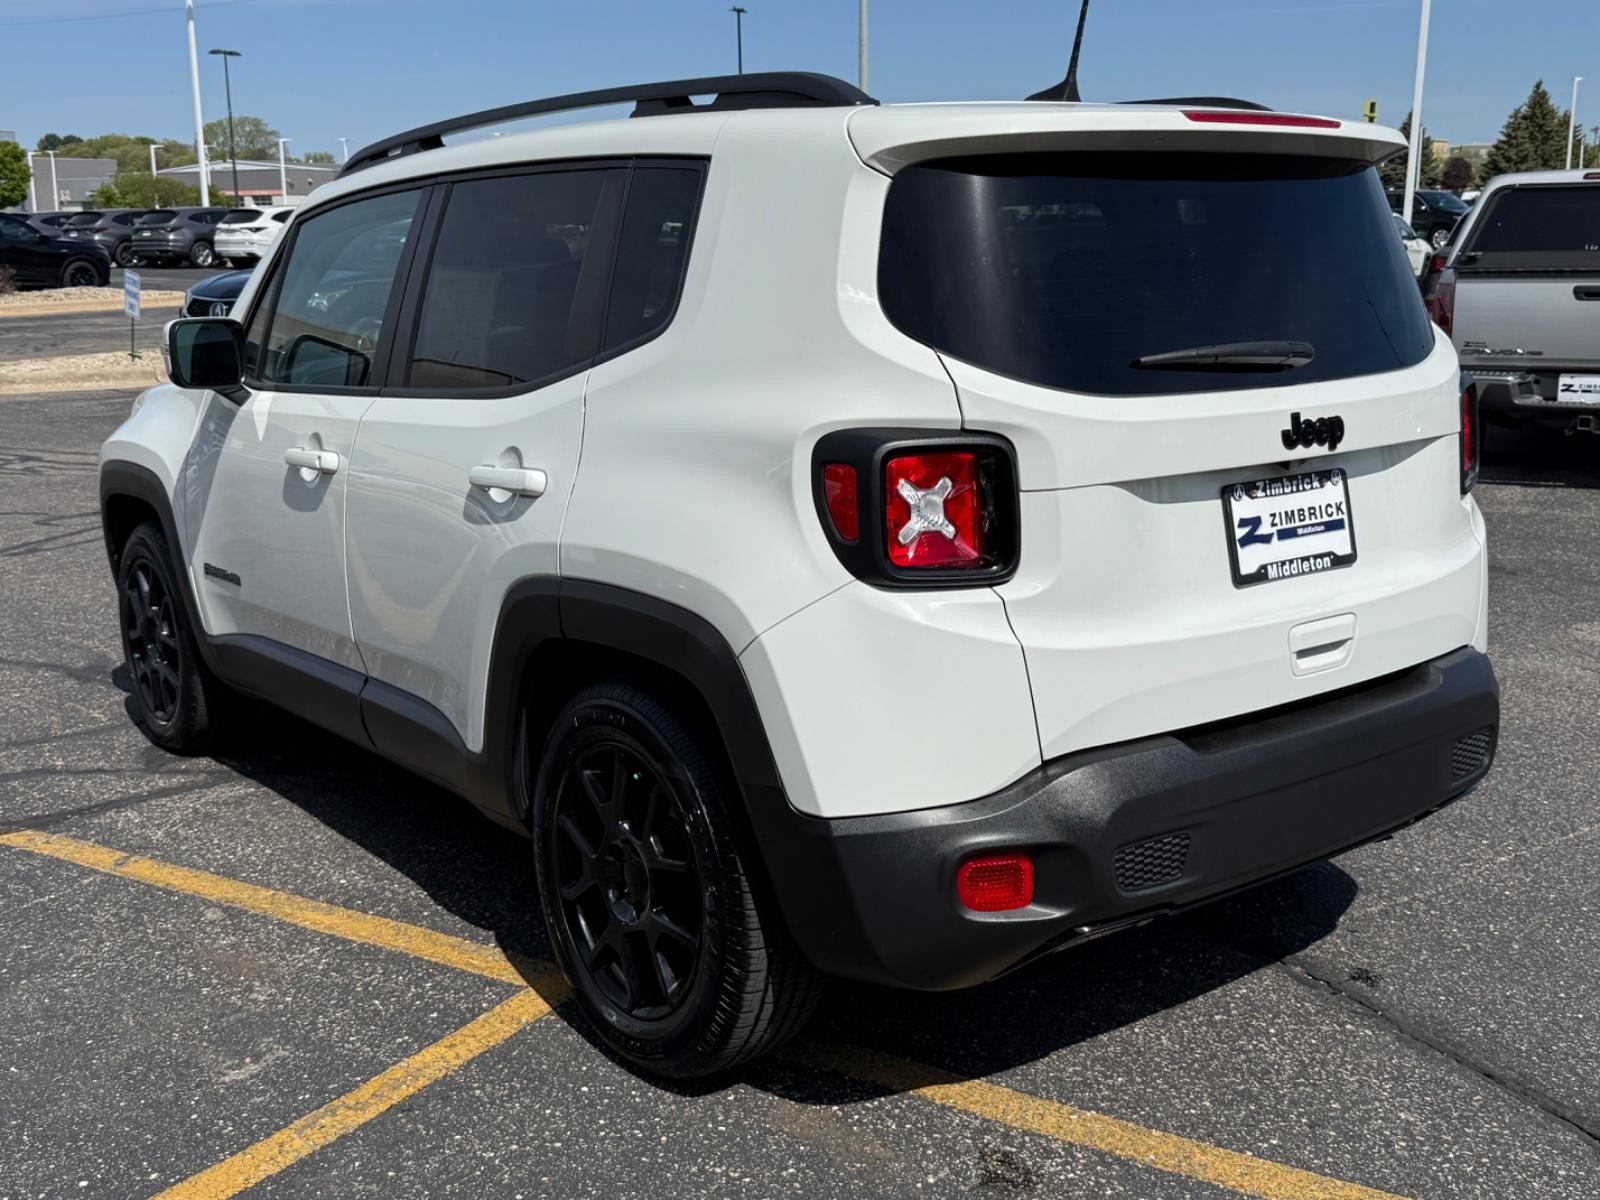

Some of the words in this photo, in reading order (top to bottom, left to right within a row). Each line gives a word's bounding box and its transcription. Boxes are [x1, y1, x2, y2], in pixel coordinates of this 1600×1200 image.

[1560, 383, 1578, 393] Z
[1281, 411, 1344, 451] Jeep
[1256, 473, 1321, 497] Zimbrick
[1237, 515, 1274, 549] Z
[1269, 501, 1345, 527] ZIMBRICK
[1296, 524, 1326, 535] Middleton
[1266, 556, 1331, 580] Middleton
